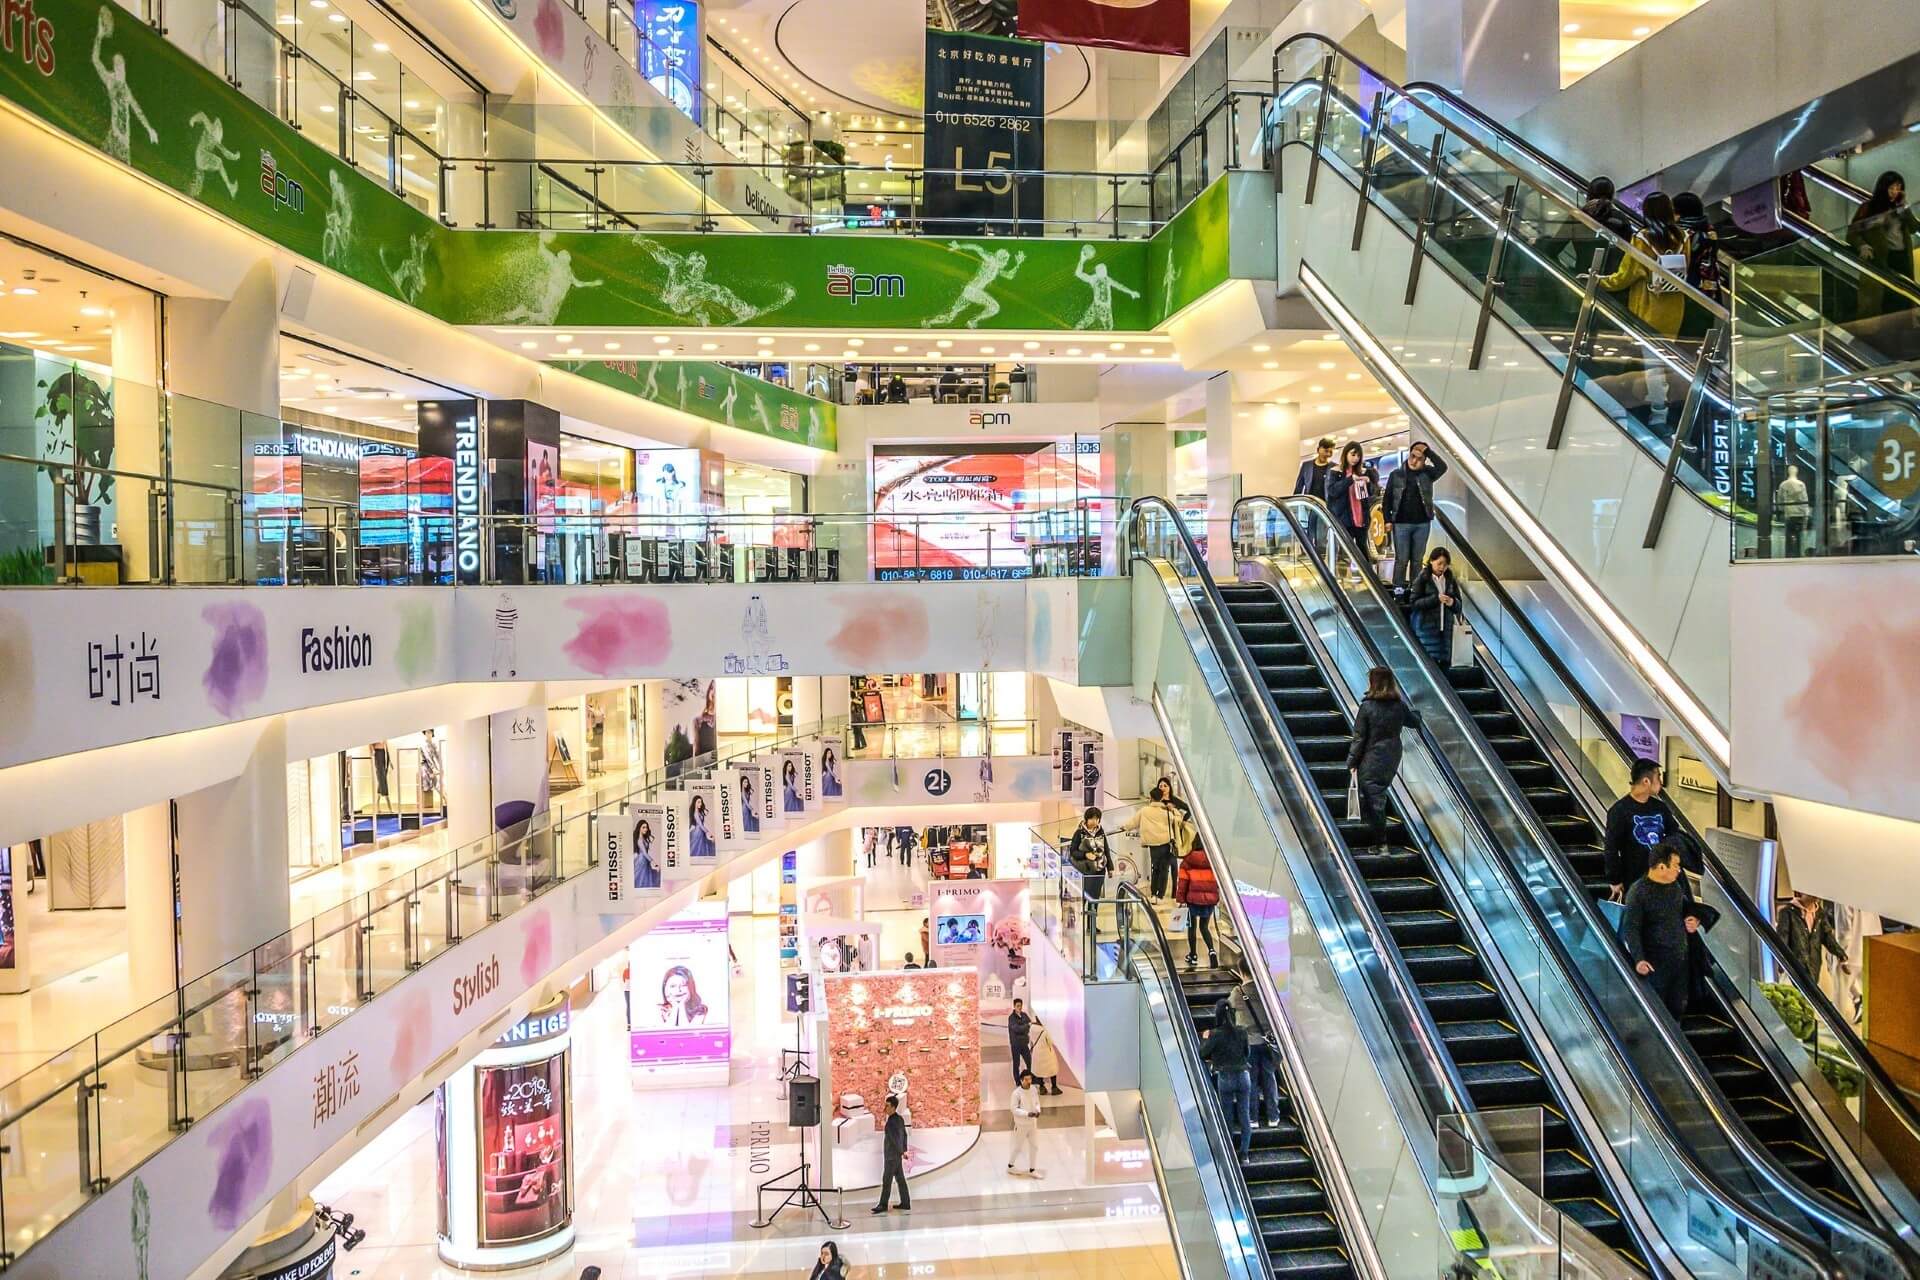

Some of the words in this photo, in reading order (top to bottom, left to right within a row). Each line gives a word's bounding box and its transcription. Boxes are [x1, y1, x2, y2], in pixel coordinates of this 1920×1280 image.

[936, 110, 959, 125] 010
[963, 113, 996, 128] 6526
[999, 116, 1030, 132] 2862
[955, 146, 1012, 195] L5
[745, 183, 779, 224] Delicious
[827, 274, 904, 305] apm
[969, 413, 1010, 429] apm
[1883, 439, 1916, 482] 3F
[456, 416, 479, 571] TRENDIANO
[930, 569, 953, 580] 6819
[88, 631, 160, 706] 时尚
[301, 625, 372, 673] Fashion
[764, 767, 773, 805] TISSOT
[927, 772, 948, 792] 2F
[720, 783, 730, 824] TISSOT
[667, 806, 676, 850] TISSOT
[608, 832, 618, 881] TISSOT
[937, 888, 981, 897] I-PRIMO
[453, 954, 500, 1015] Stylish
[313, 1049, 360, 1128] 潮流
[750, 1120, 770, 1174] I-PRIMO
[298, 1263, 310, 1278] UP
[310, 1252, 324, 1272] FOR
